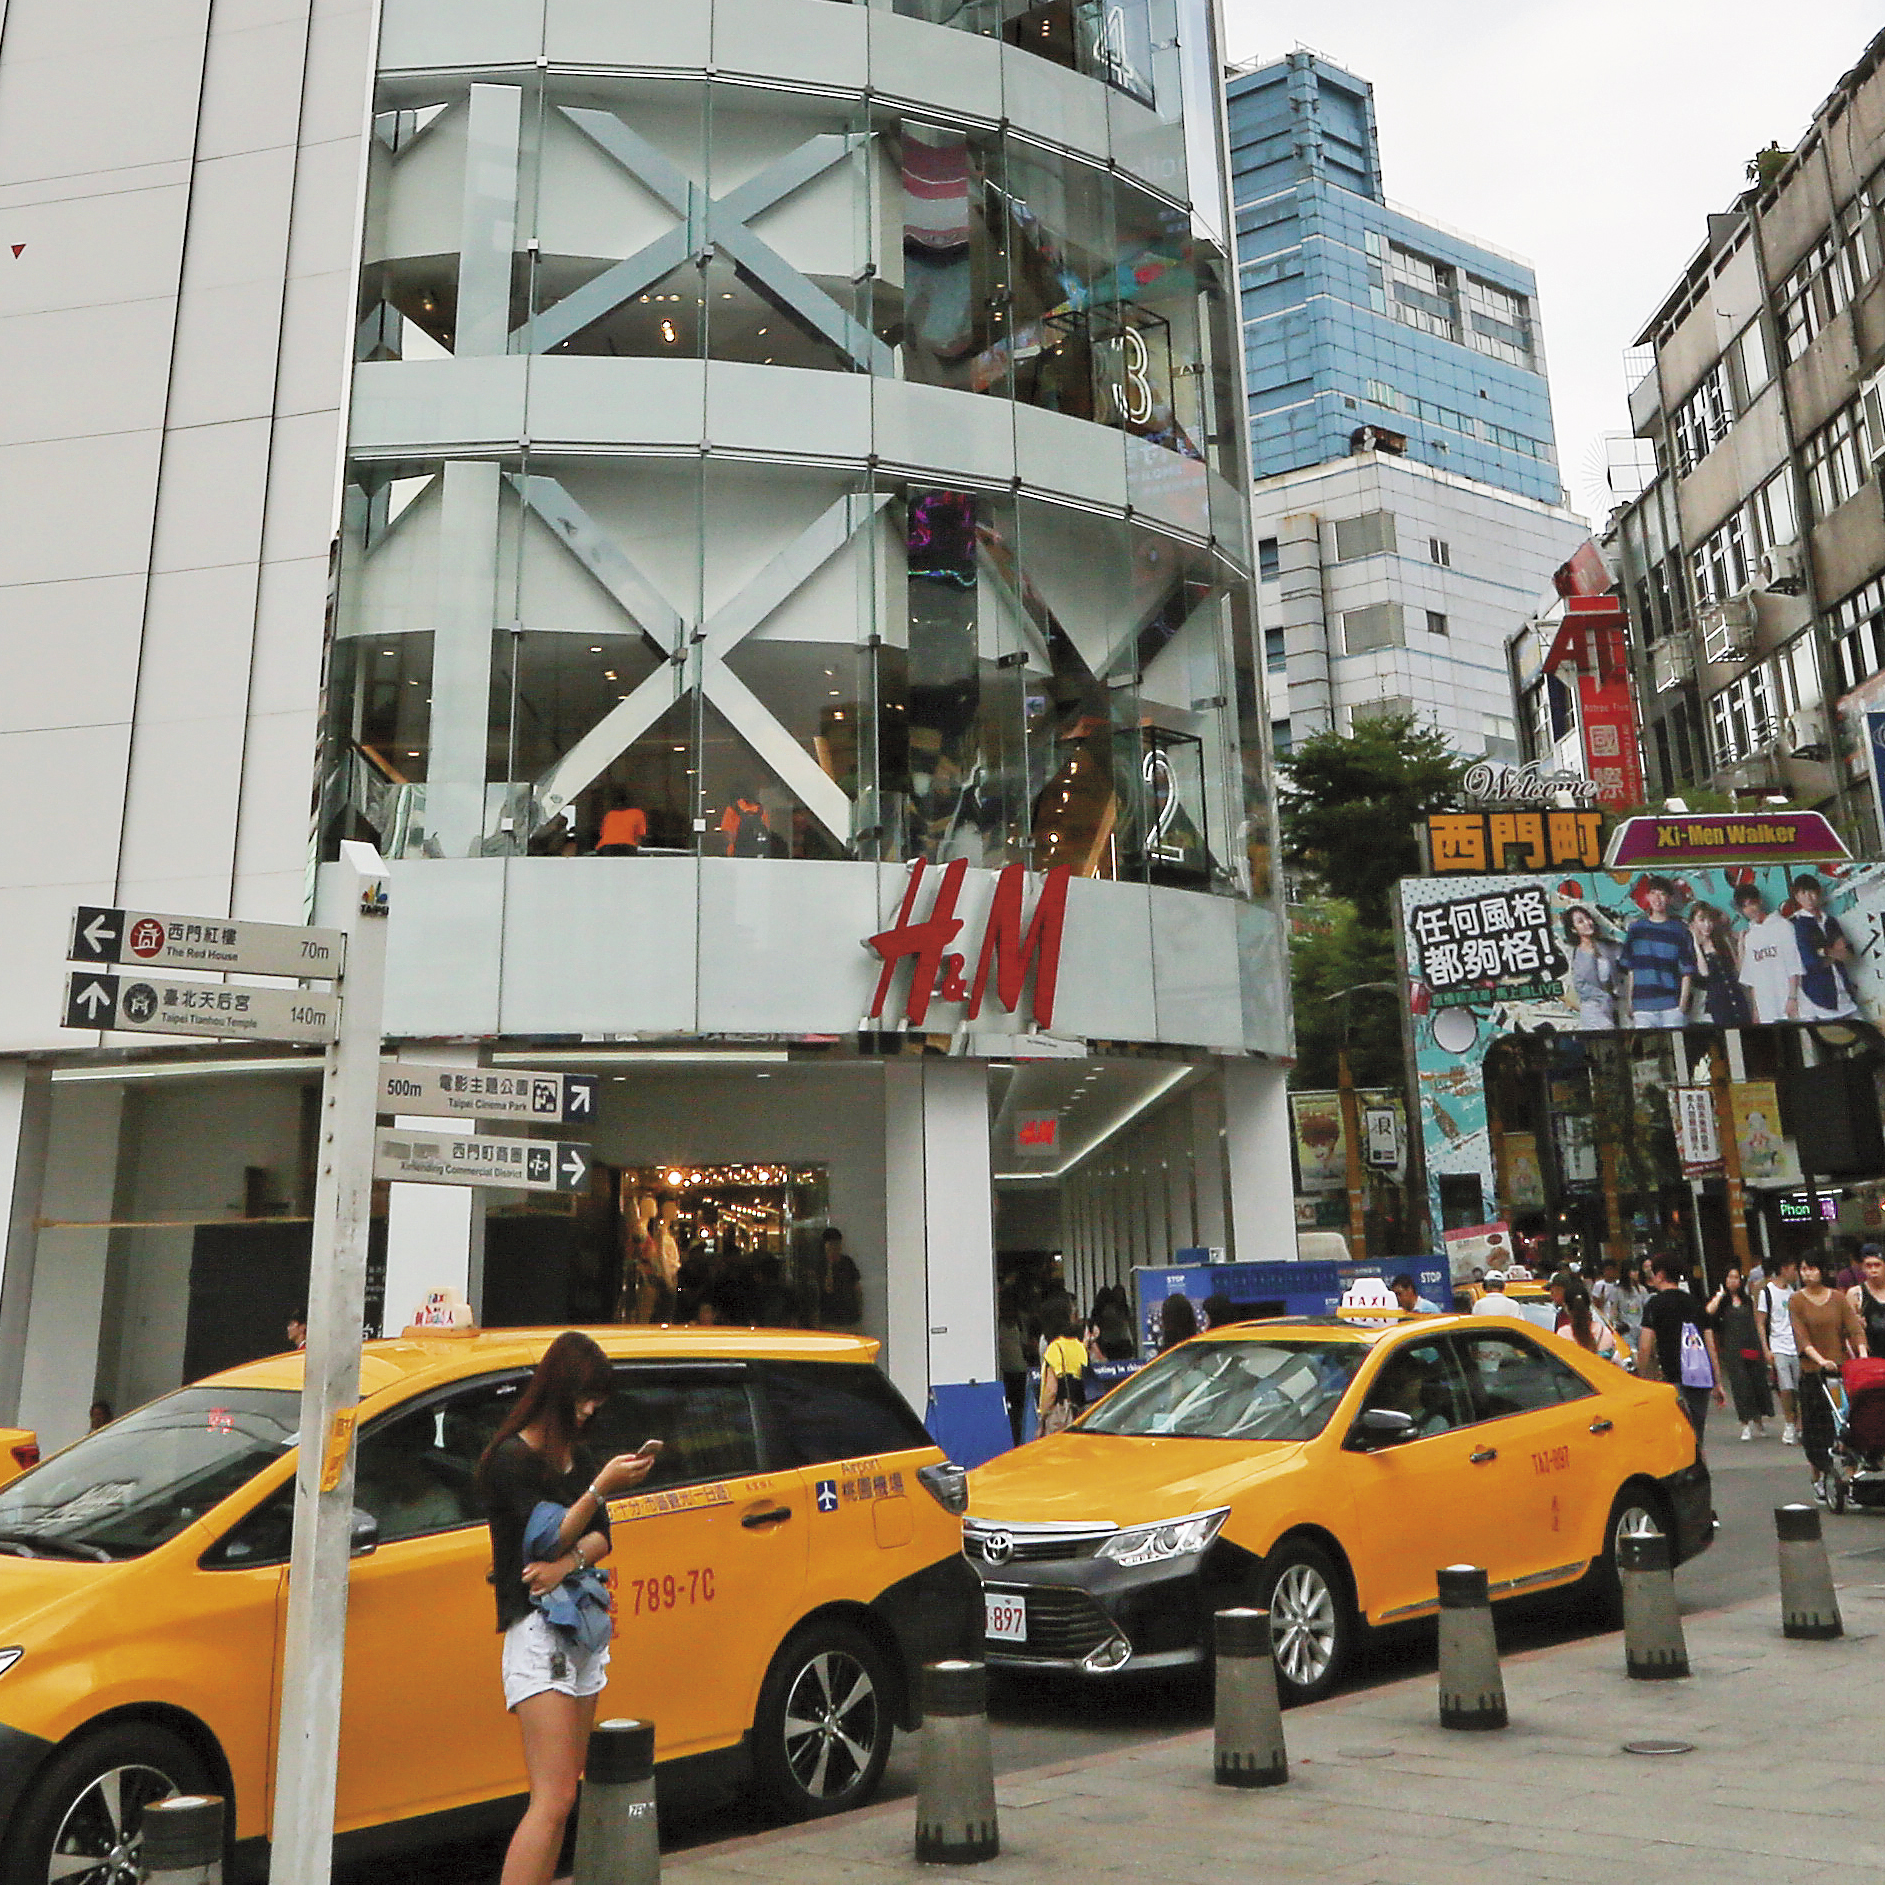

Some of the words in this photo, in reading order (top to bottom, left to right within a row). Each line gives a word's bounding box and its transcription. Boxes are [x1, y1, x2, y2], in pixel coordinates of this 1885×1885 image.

[1462, 760, 1598, 802] Welcome
[1428, 812, 1603, 872] 西門町
[1657, 825, 1724, 848] Xi-Men
[1727, 823, 1798, 845] Walker
[360, 903, 389, 916] TAIPEI
[1415, 886, 1548, 945] 任何風格
[168, 921, 238, 946] 西門紅樓
[300, 941, 329, 960] 70m
[861, 856, 1071, 1030] H&M
[166, 946, 183, 957] The
[186, 948, 205, 959] Red
[206, 950, 238, 962] House
[1424, 927, 1554, 986] 都夠格!
[163, 987, 251, 1012] 臺北天后宮
[291, 1006, 326, 1026] 140m
[162, 1012, 188, 1026] Taipei
[190, 1014, 225, 1027] Tianhou
[227, 1016, 258, 1029] Temple
[387, 1078, 422, 1097] 500m
[439, 1073, 529, 1096] 電影主題公園
[448, 1098, 473, 1110] Taipei
[475, 1099, 507, 1111] Cinema
[508, 1100, 527, 1111] Park
[1019, 1119, 1058, 1145] H&M
[445, 1164, 493, 1178] Commercial
[494, 1167, 522, 1179] District
[1167, 1275, 1186, 1284] STOP
[1421, 1271, 1442, 1283] STOP
[1349, 1296, 1386, 1307] TAXI
[841, 1458, 882, 1475] Airport
[632, 1568, 716, 1616] 789-7C
